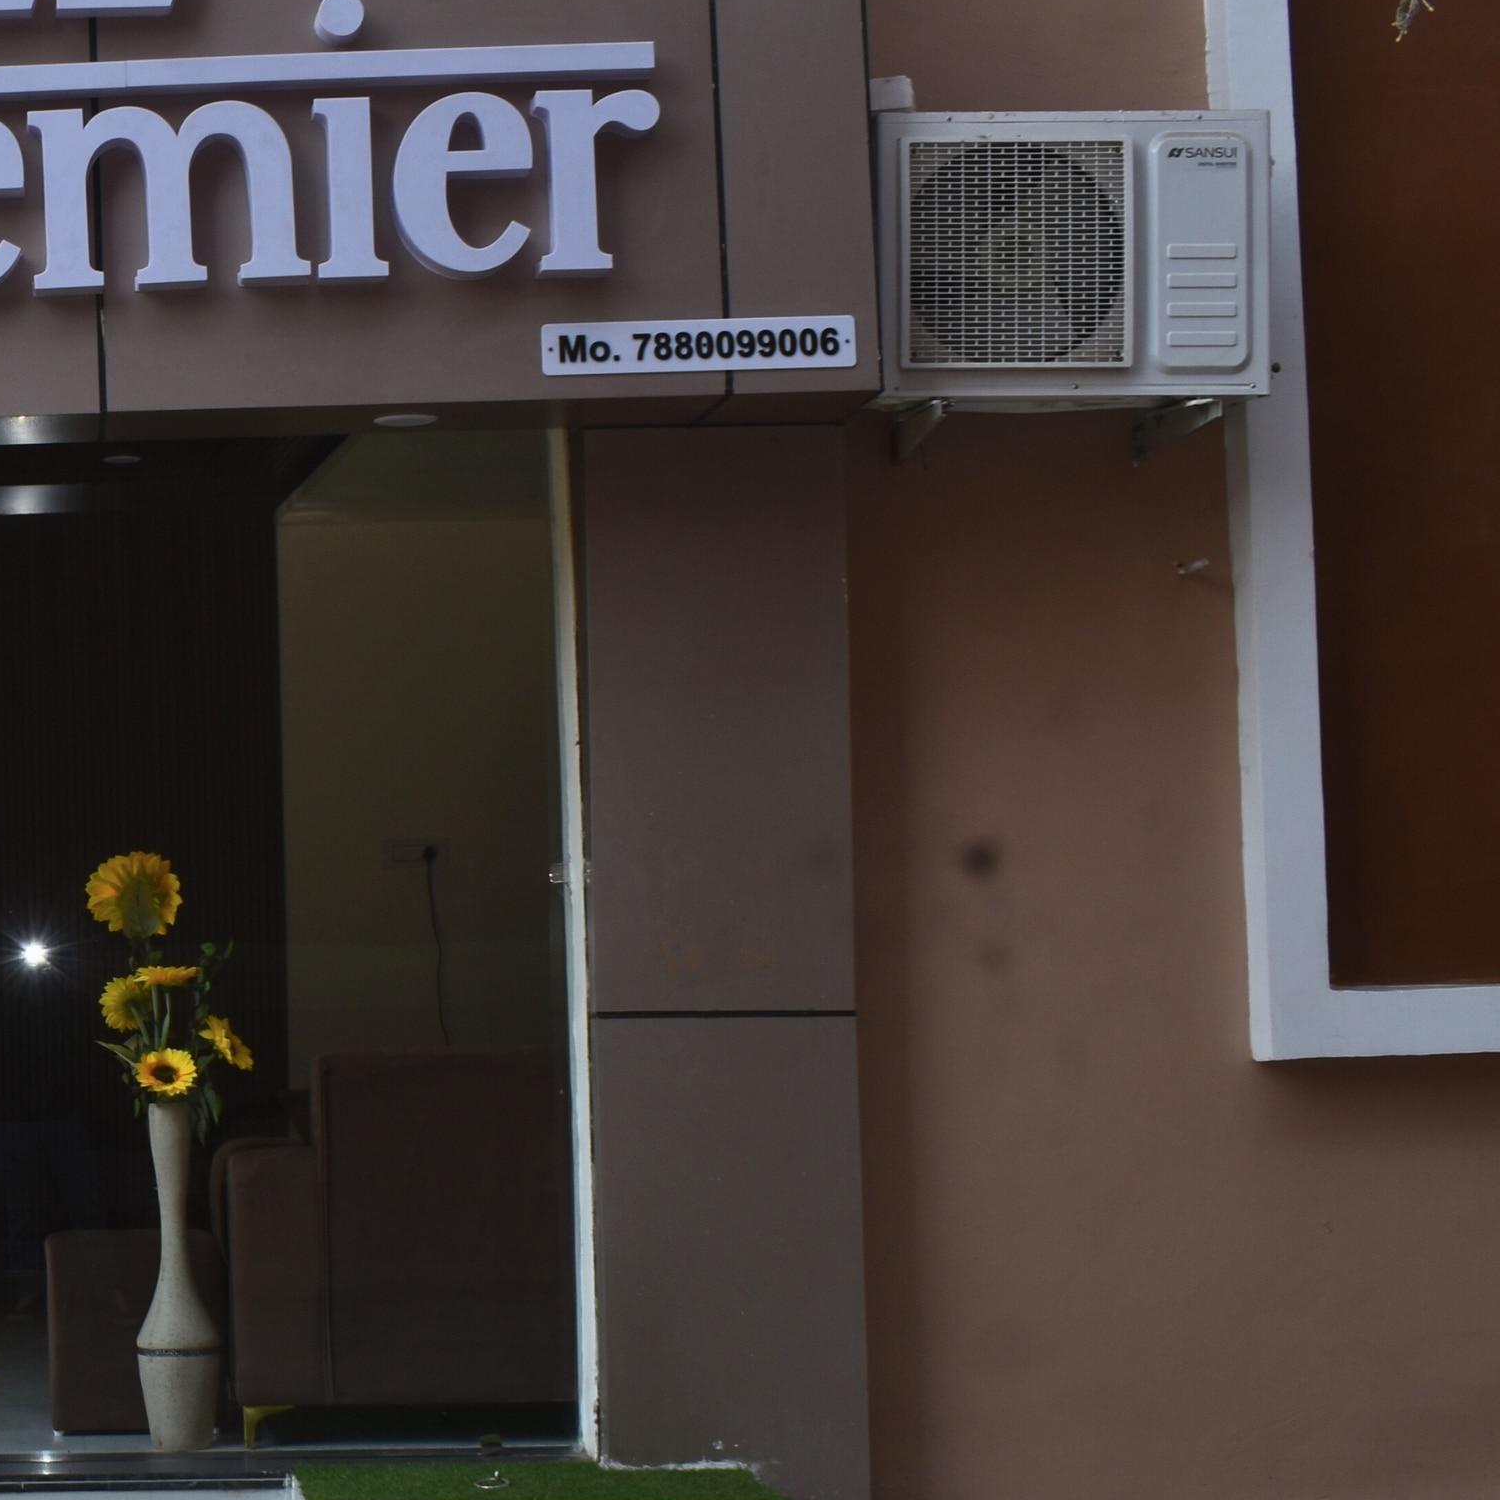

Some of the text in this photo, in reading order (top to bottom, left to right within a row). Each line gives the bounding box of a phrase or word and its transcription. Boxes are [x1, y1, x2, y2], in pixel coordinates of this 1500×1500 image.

[1185, 147, 1238, 158] SANSUI
[558, 327, 841, 364] Mo. 7880099006
